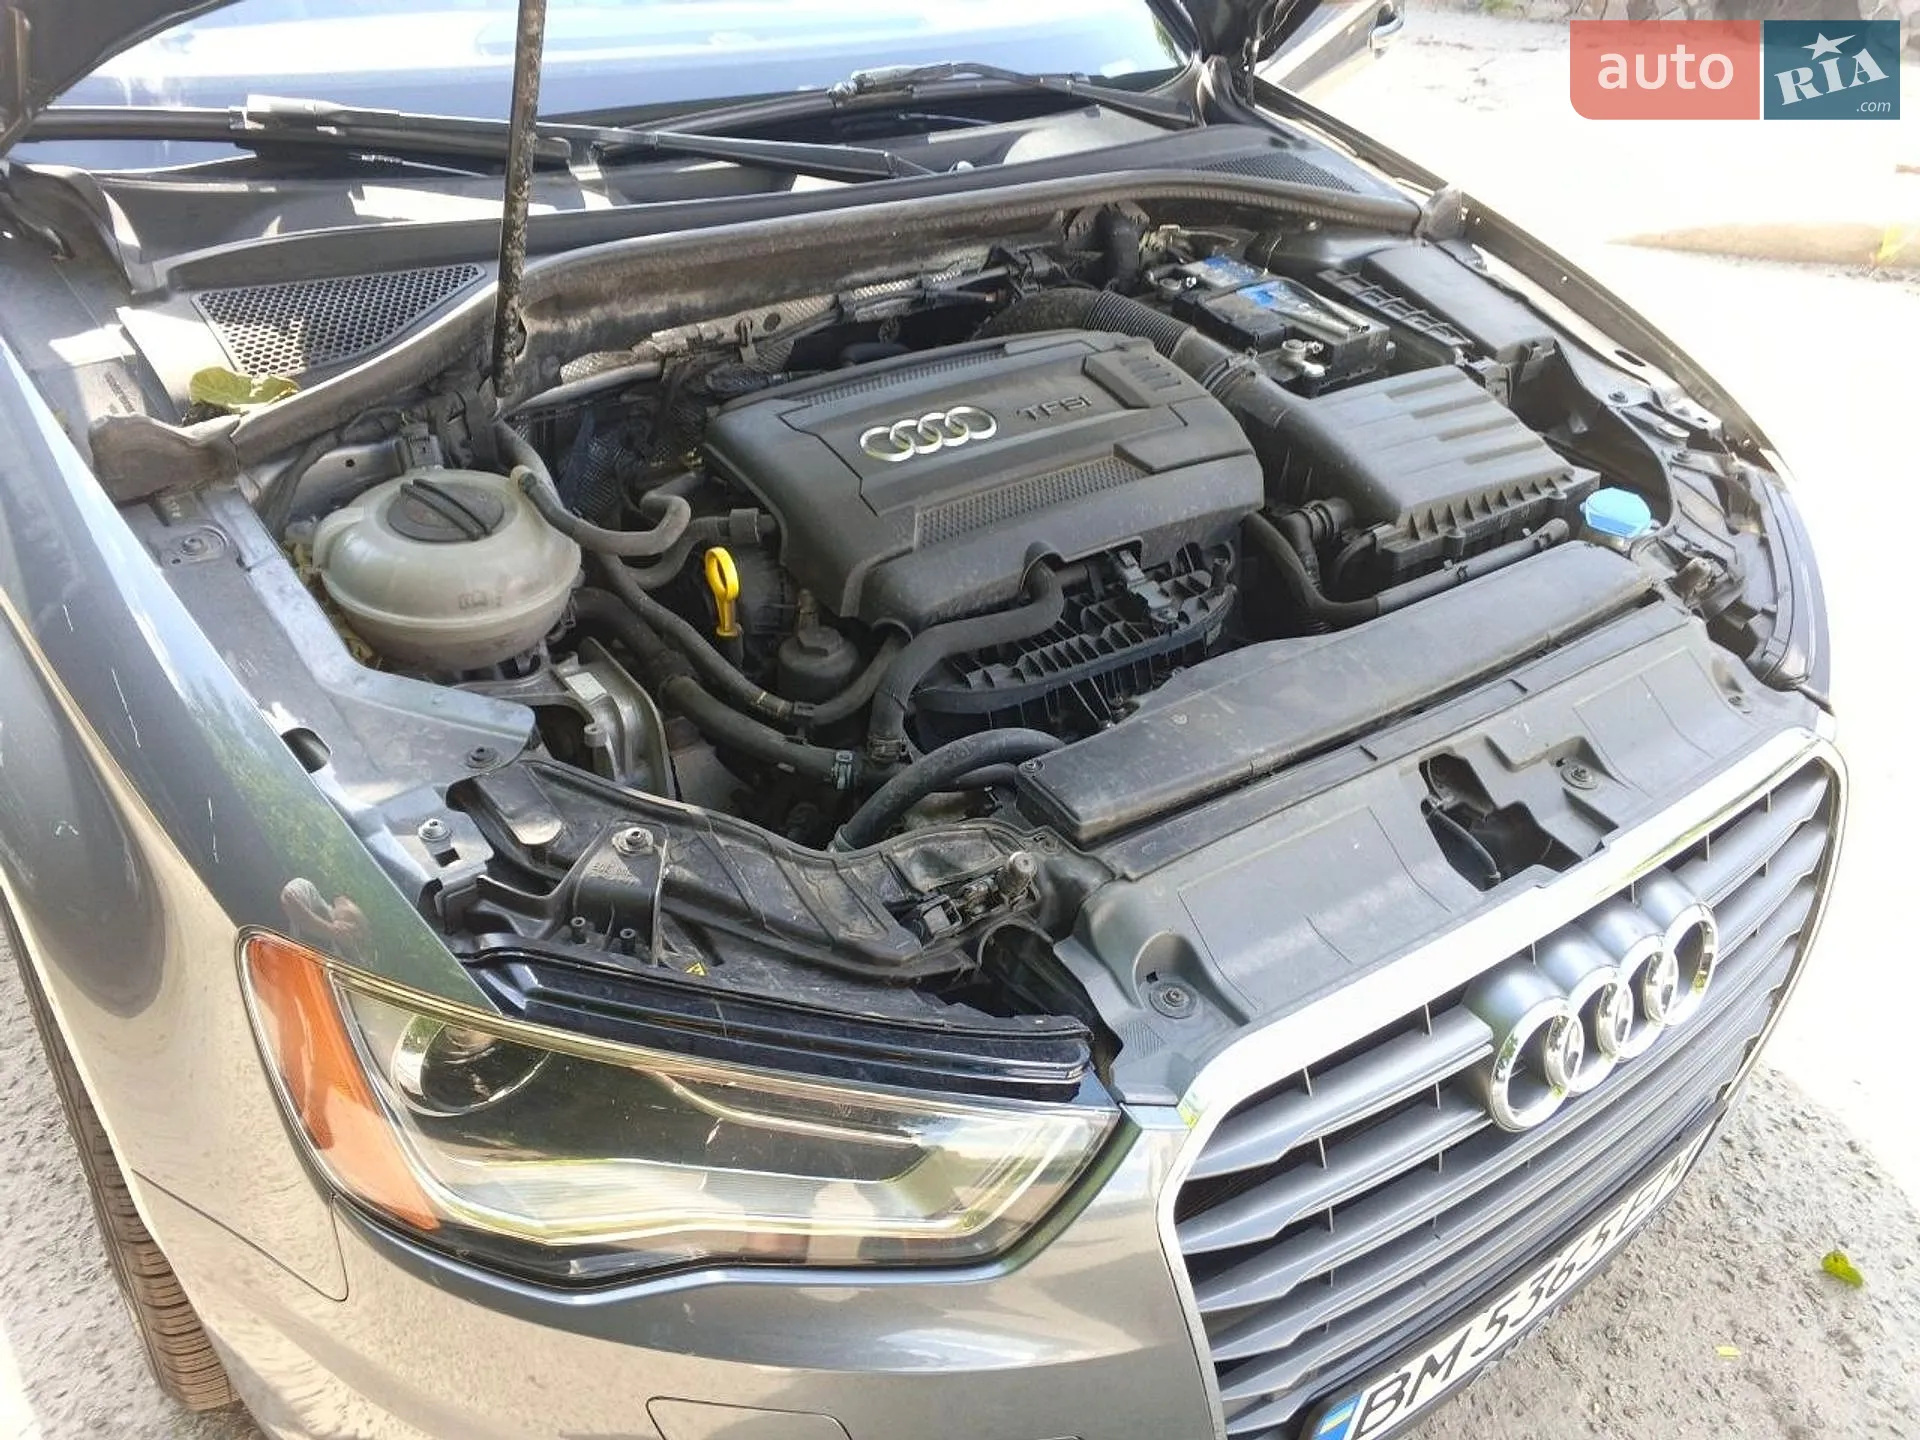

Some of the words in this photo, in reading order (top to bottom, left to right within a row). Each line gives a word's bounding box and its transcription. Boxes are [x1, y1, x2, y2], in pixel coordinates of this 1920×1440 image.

[1015, 394, 1093, 422] TFSI
[1351, 1326, 1472, 1440] BM
[1469, 1207, 1623, 1358] 5365
